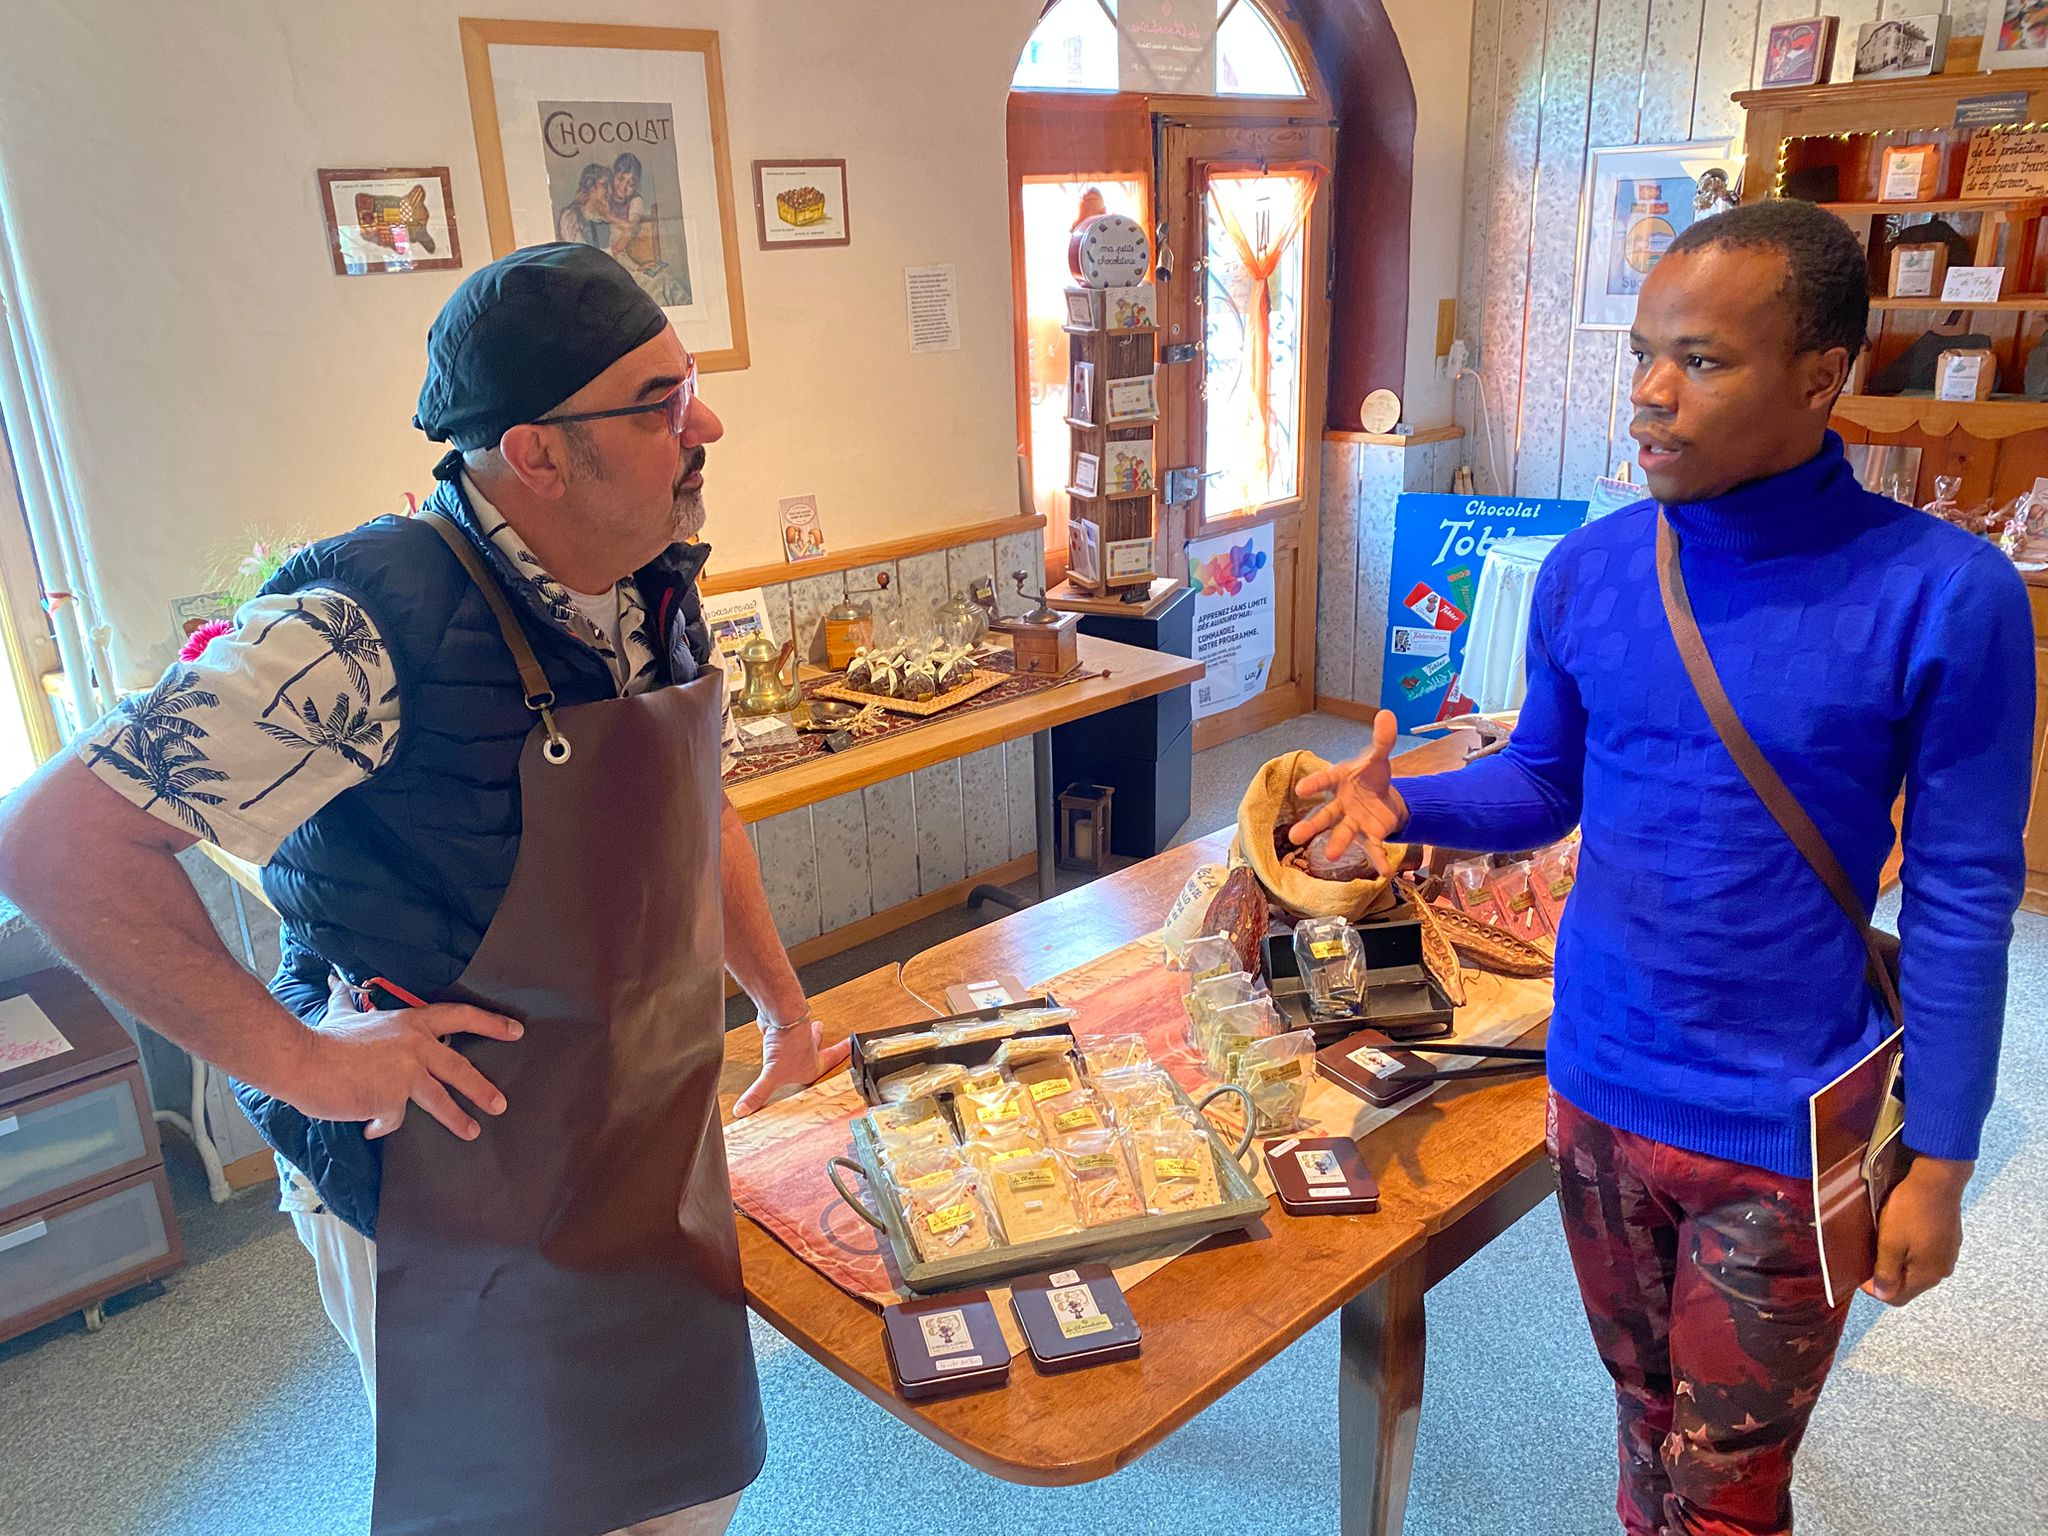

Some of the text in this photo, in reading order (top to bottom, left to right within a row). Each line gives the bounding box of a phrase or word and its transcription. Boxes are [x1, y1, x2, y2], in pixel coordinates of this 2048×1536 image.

[544, 111, 670, 158] CHOCOLAT
[1115, 244, 1135, 255] petite
[1097, 255, 1136, 265] chocolaterie
[1465, 500, 1541, 518] Chocolat
[1198, 597, 1268, 624] APPRENEZ SANS LIMITE
[1440, 605, 1460, 621] Tobler
[1198, 626, 1235, 644] COMMANDEZ
[1198, 628, 1259, 653] NOTRE PROGRAMME.
[1426, 659, 1446, 674] Tobler
